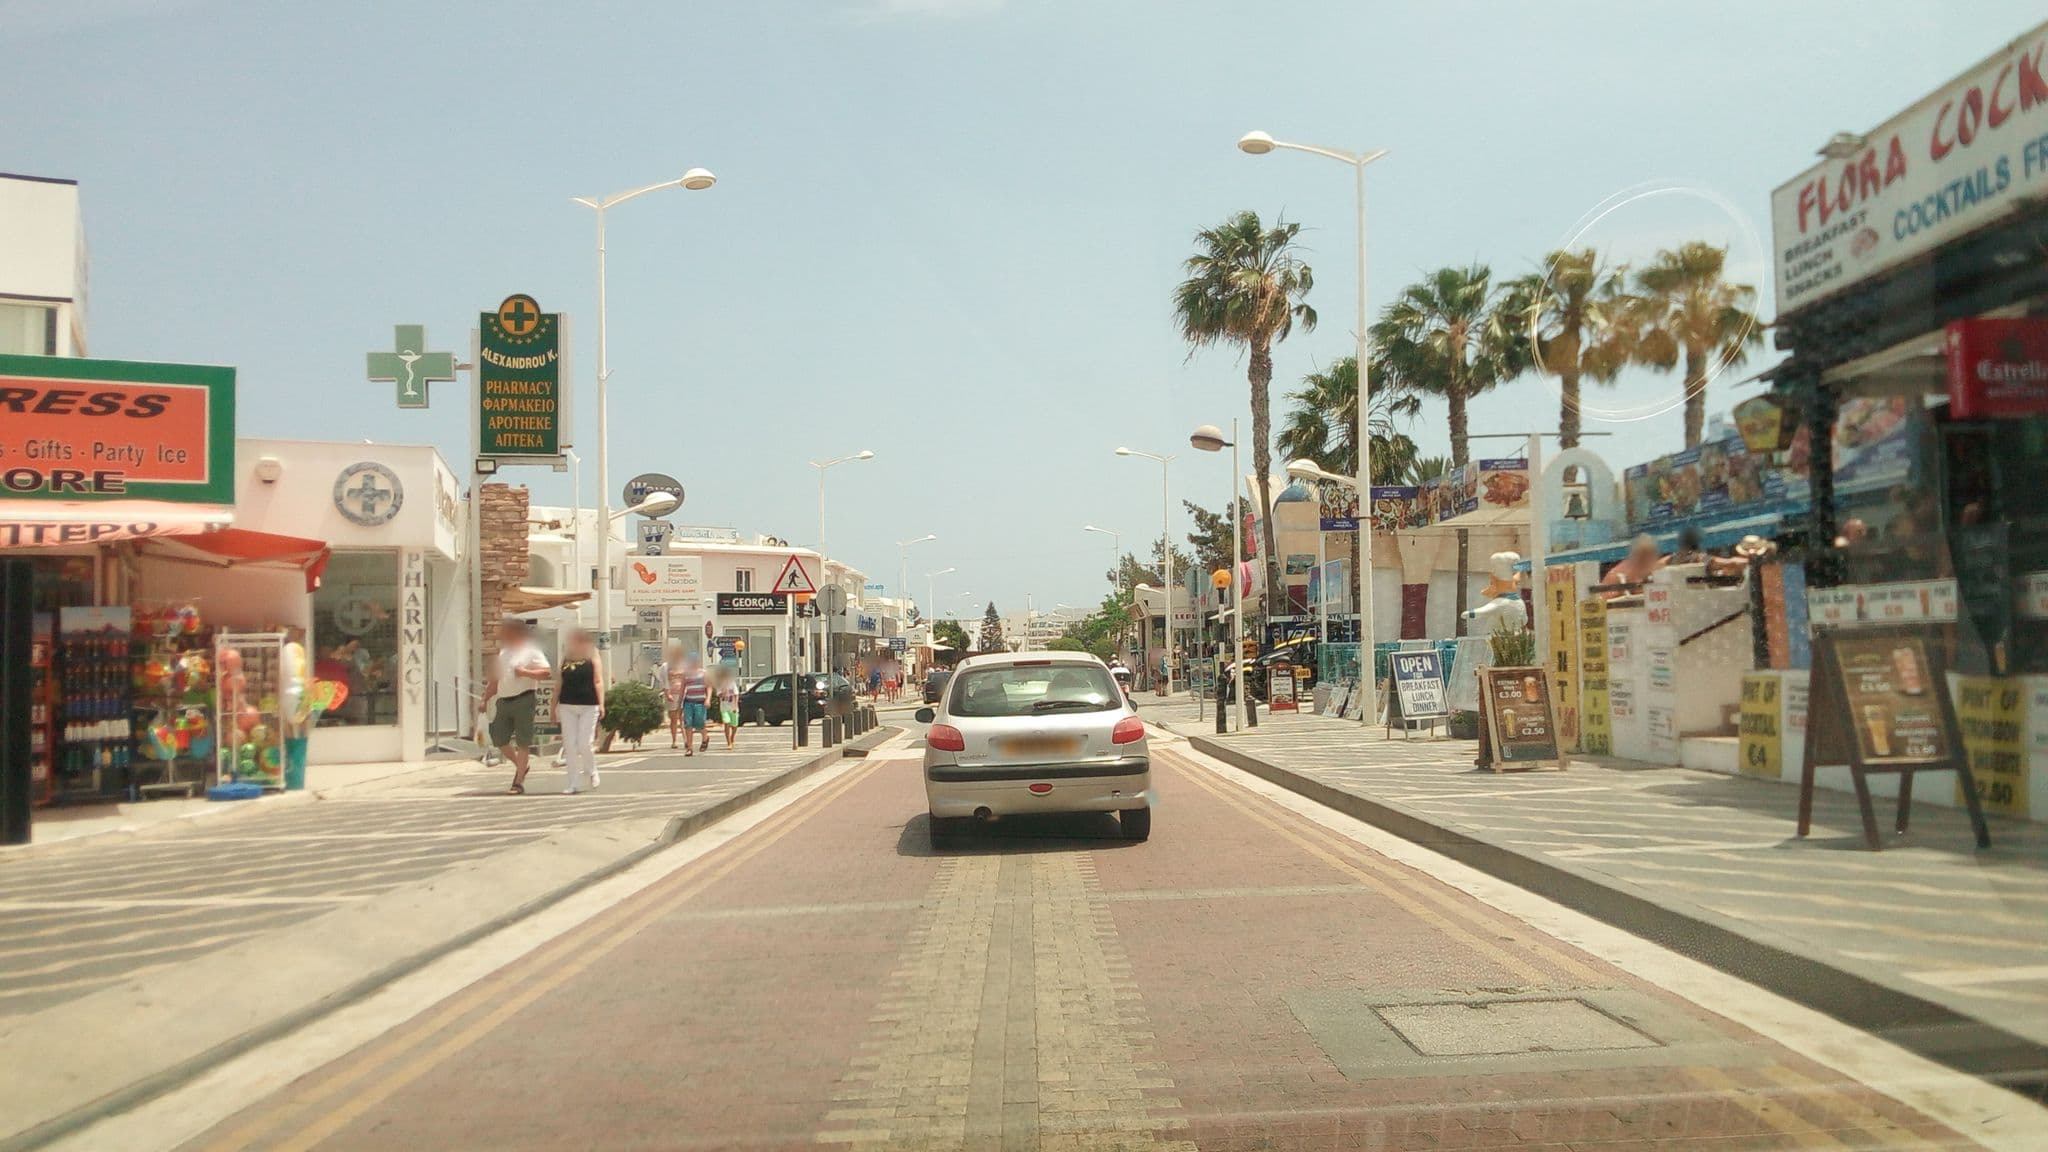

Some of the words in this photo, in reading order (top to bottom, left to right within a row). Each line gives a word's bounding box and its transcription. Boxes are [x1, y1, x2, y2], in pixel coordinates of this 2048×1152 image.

[1797, 133, 1908, 234] FLORA
[1893, 153, 2012, 243] COCKTAILS
[1784, 209, 1867, 263] BREAKFAST
[1785, 248, 1833, 281] LUNCH
[1785, 262, 1842, 299] SNACKS
[481, 347, 546, 370] ALEXANDROU
[547, 348, 559, 364] K.
[486, 380, 552, 395] PHARMACY
[482, 398, 555, 412] ΦΑΡΜΑΚΕΙΟ
[488, 416, 552, 430] APOTHEKE
[25, 439, 73, 460] Gifts
[93, 441, 145, 467] Party
[157, 443, 188, 464] Ice
[732, 597, 775, 609] GEORGIA
[403, 552, 425, 705] PHARMACY
[1400, 655, 1433, 673] OPEN
[1401, 680, 1440, 692] BREAKFAST
[1412, 691, 1434, 702] LUNCH
[1412, 702, 1438, 712] DINNER
